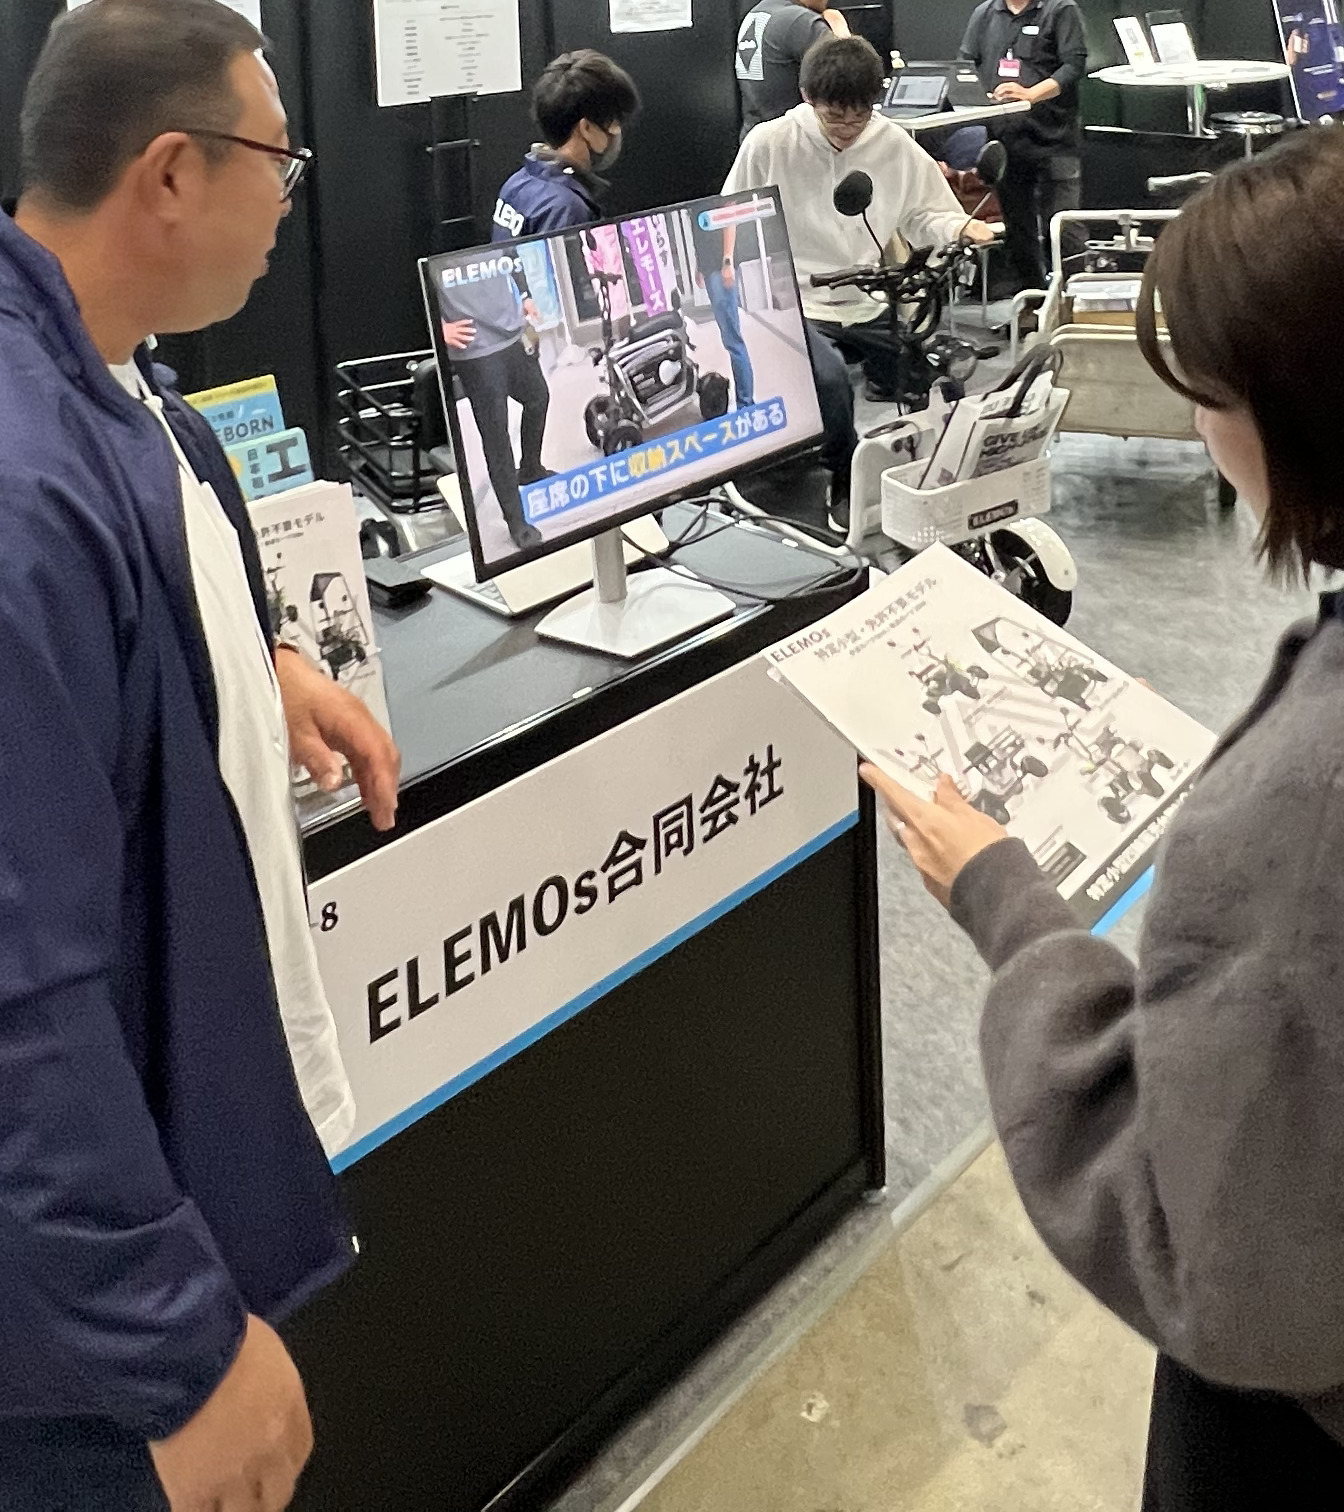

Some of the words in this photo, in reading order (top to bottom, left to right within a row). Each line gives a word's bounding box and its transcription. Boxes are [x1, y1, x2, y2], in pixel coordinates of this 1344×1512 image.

[441, 256, 523, 289] ELEMOs
[630, 218, 665, 311] エレモース
[770, 628, 831, 662] ELEMOs
[367, 743, 784, 1044] ELEMOs合同会社
